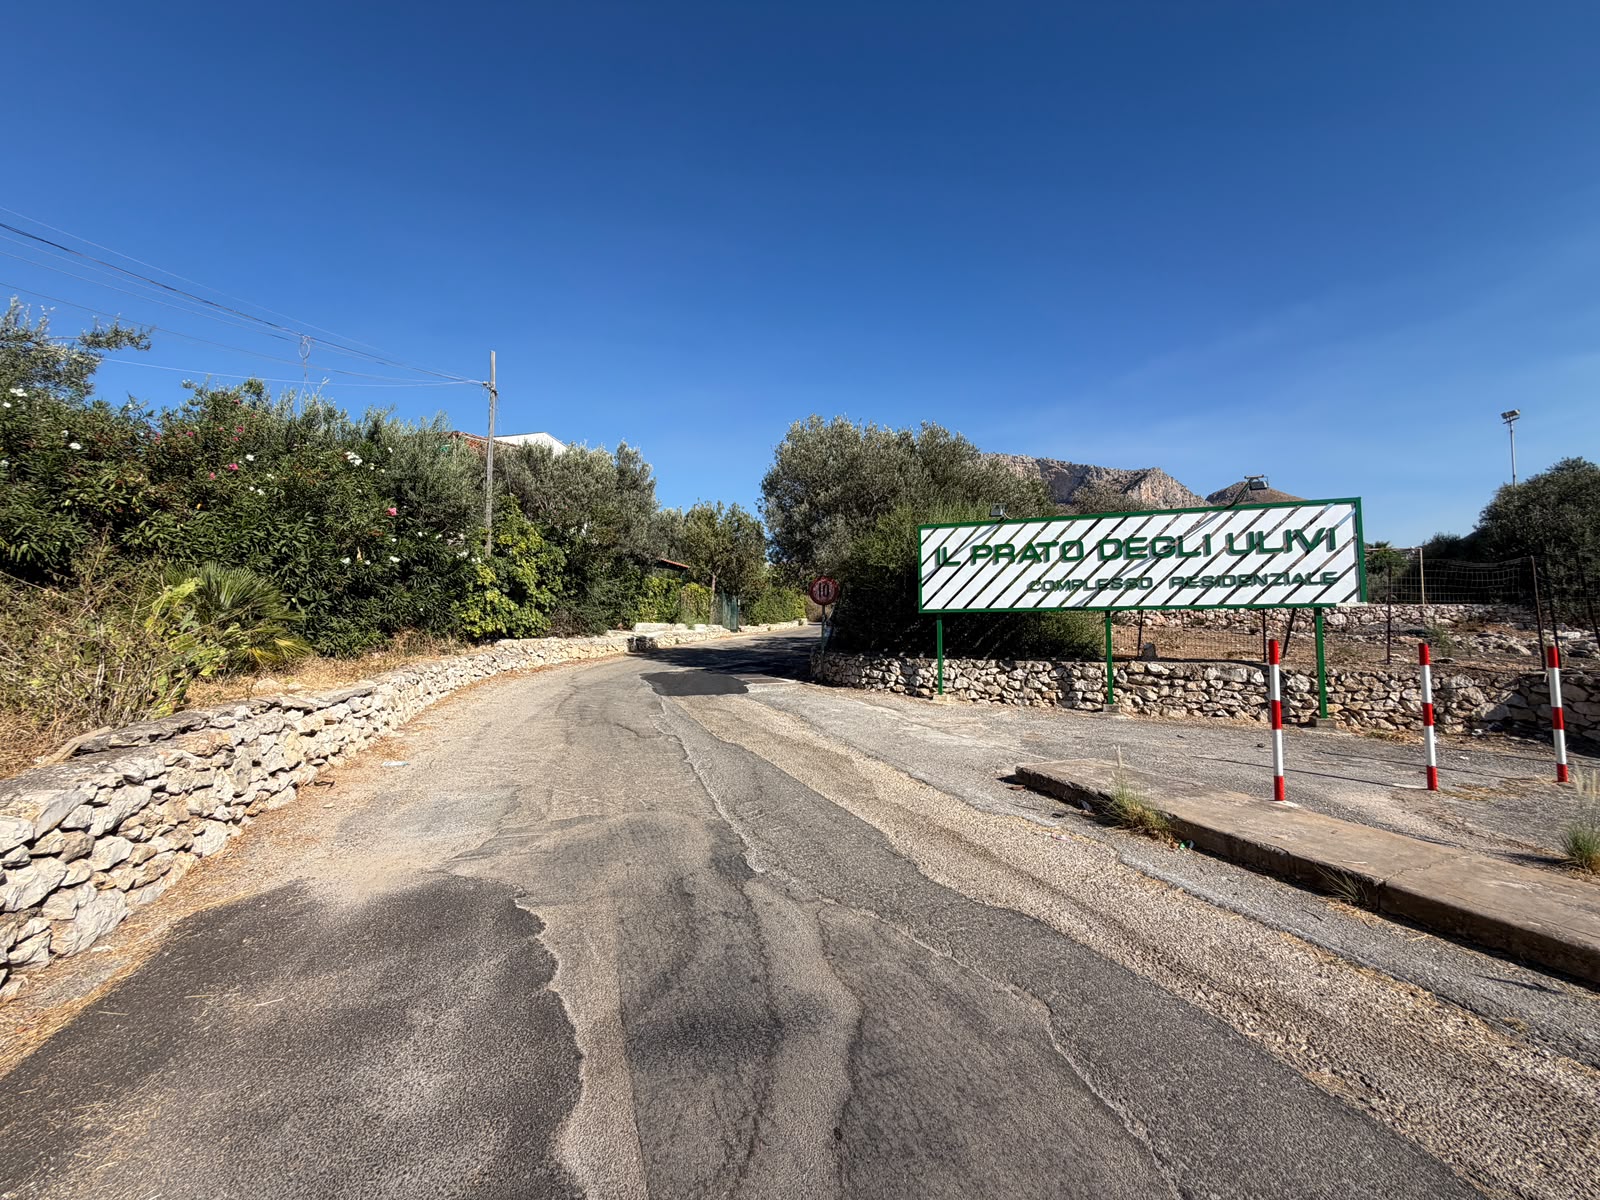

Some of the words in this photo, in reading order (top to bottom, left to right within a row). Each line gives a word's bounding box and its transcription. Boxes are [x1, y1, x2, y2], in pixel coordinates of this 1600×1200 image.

[936, 546, 961, 567] IL
[970, 540, 1084, 565] PRATO
[1099, 534, 1212, 561] DEGLI
[1226, 527, 1338, 554] ULIVI
[818, 582, 830, 598] 10
[1027, 577, 1153, 593] COMPLESSO
[1168, 571, 1338, 590] RESIDENZIALE
